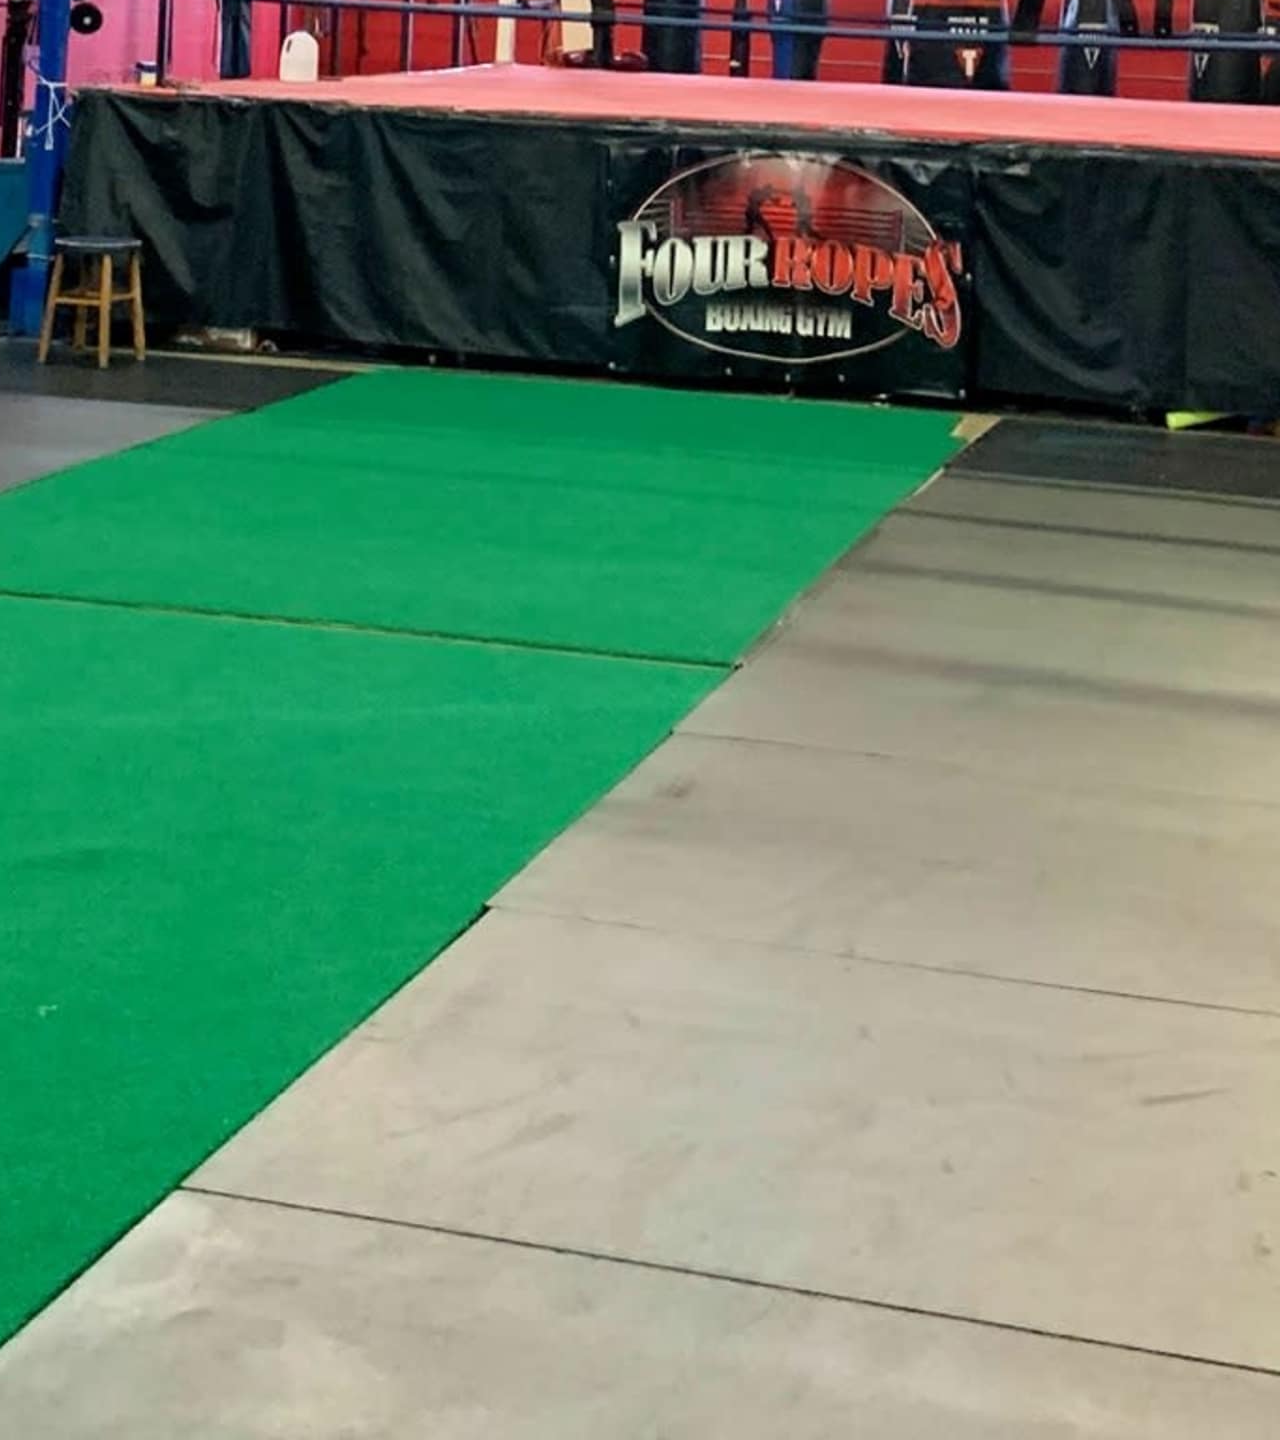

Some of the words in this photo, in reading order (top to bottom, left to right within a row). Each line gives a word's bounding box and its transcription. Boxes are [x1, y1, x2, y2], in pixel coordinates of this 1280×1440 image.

[614, 219, 770, 327] FOUR
[771, 237, 963, 349] ROPES
[705, 304, 792, 335] BOXING
[795, 307, 852, 340] GYM
